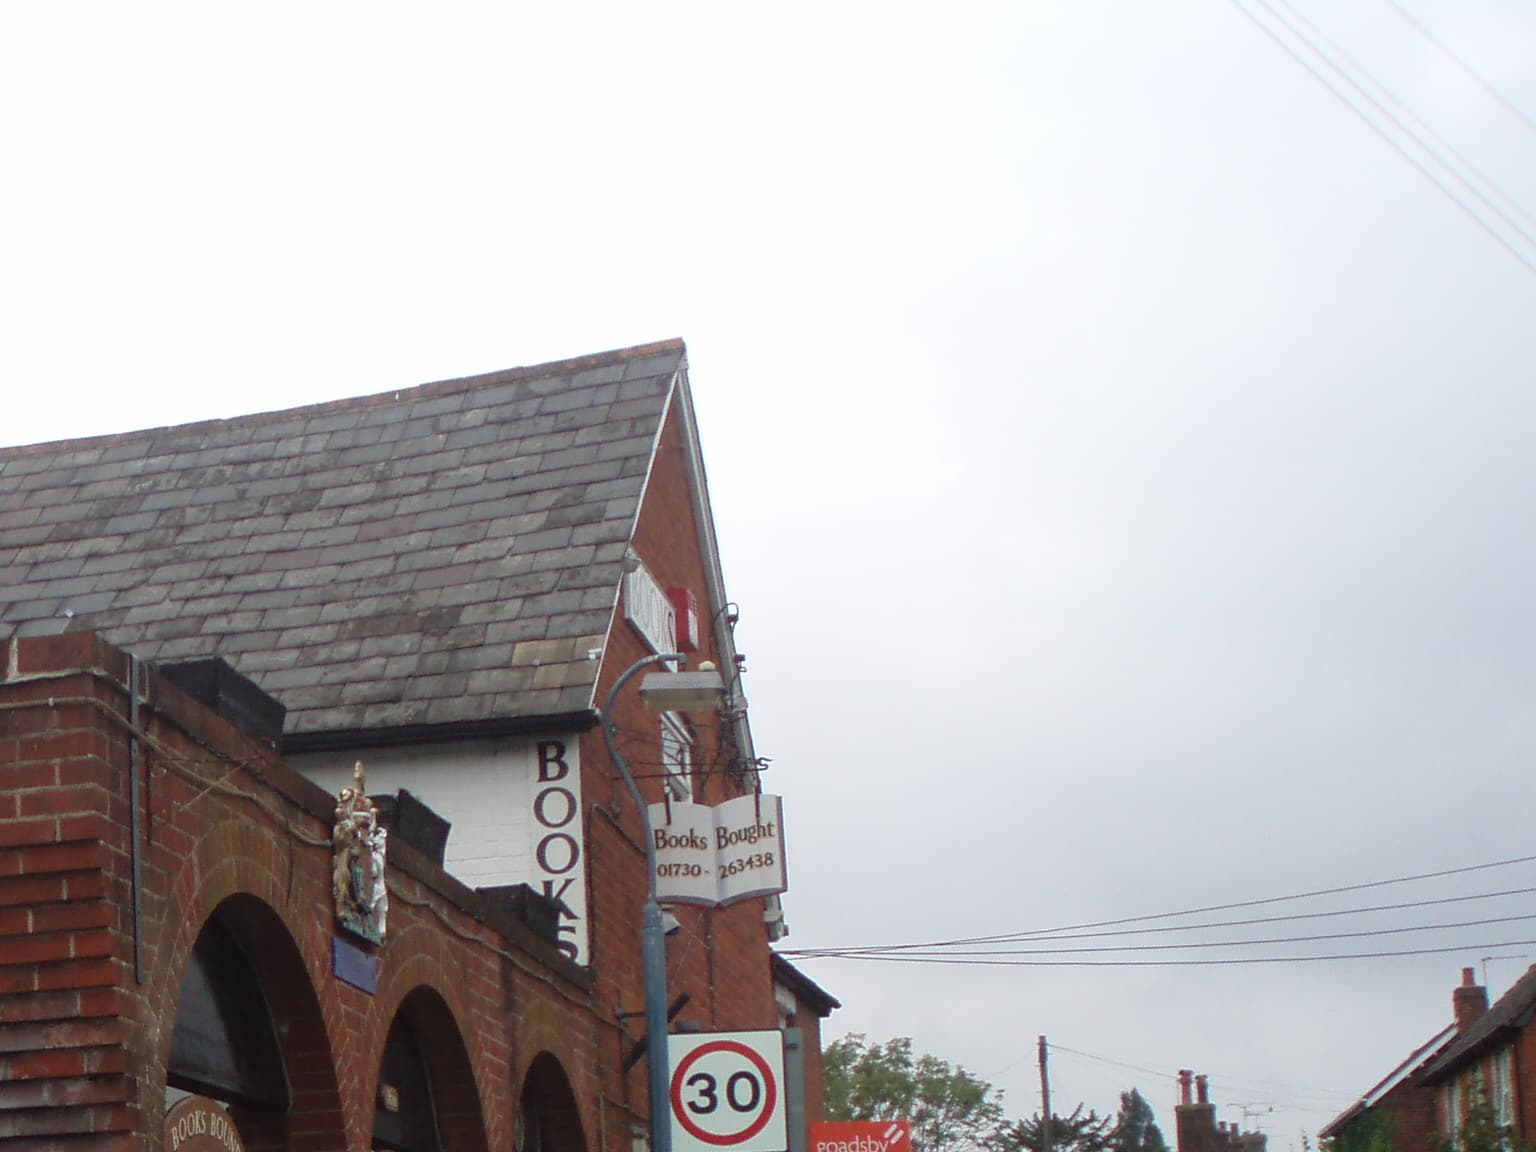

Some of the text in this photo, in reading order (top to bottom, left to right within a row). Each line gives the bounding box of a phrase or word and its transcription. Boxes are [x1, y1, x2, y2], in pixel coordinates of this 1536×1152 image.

[654, 819, 775, 850] Books Bought
[657, 864, 702, 877] 01730
[718, 852, 775, 879] 263438
[685, 1070, 762, 1115] 30
[171, 1110, 207, 1152] BOOKS
